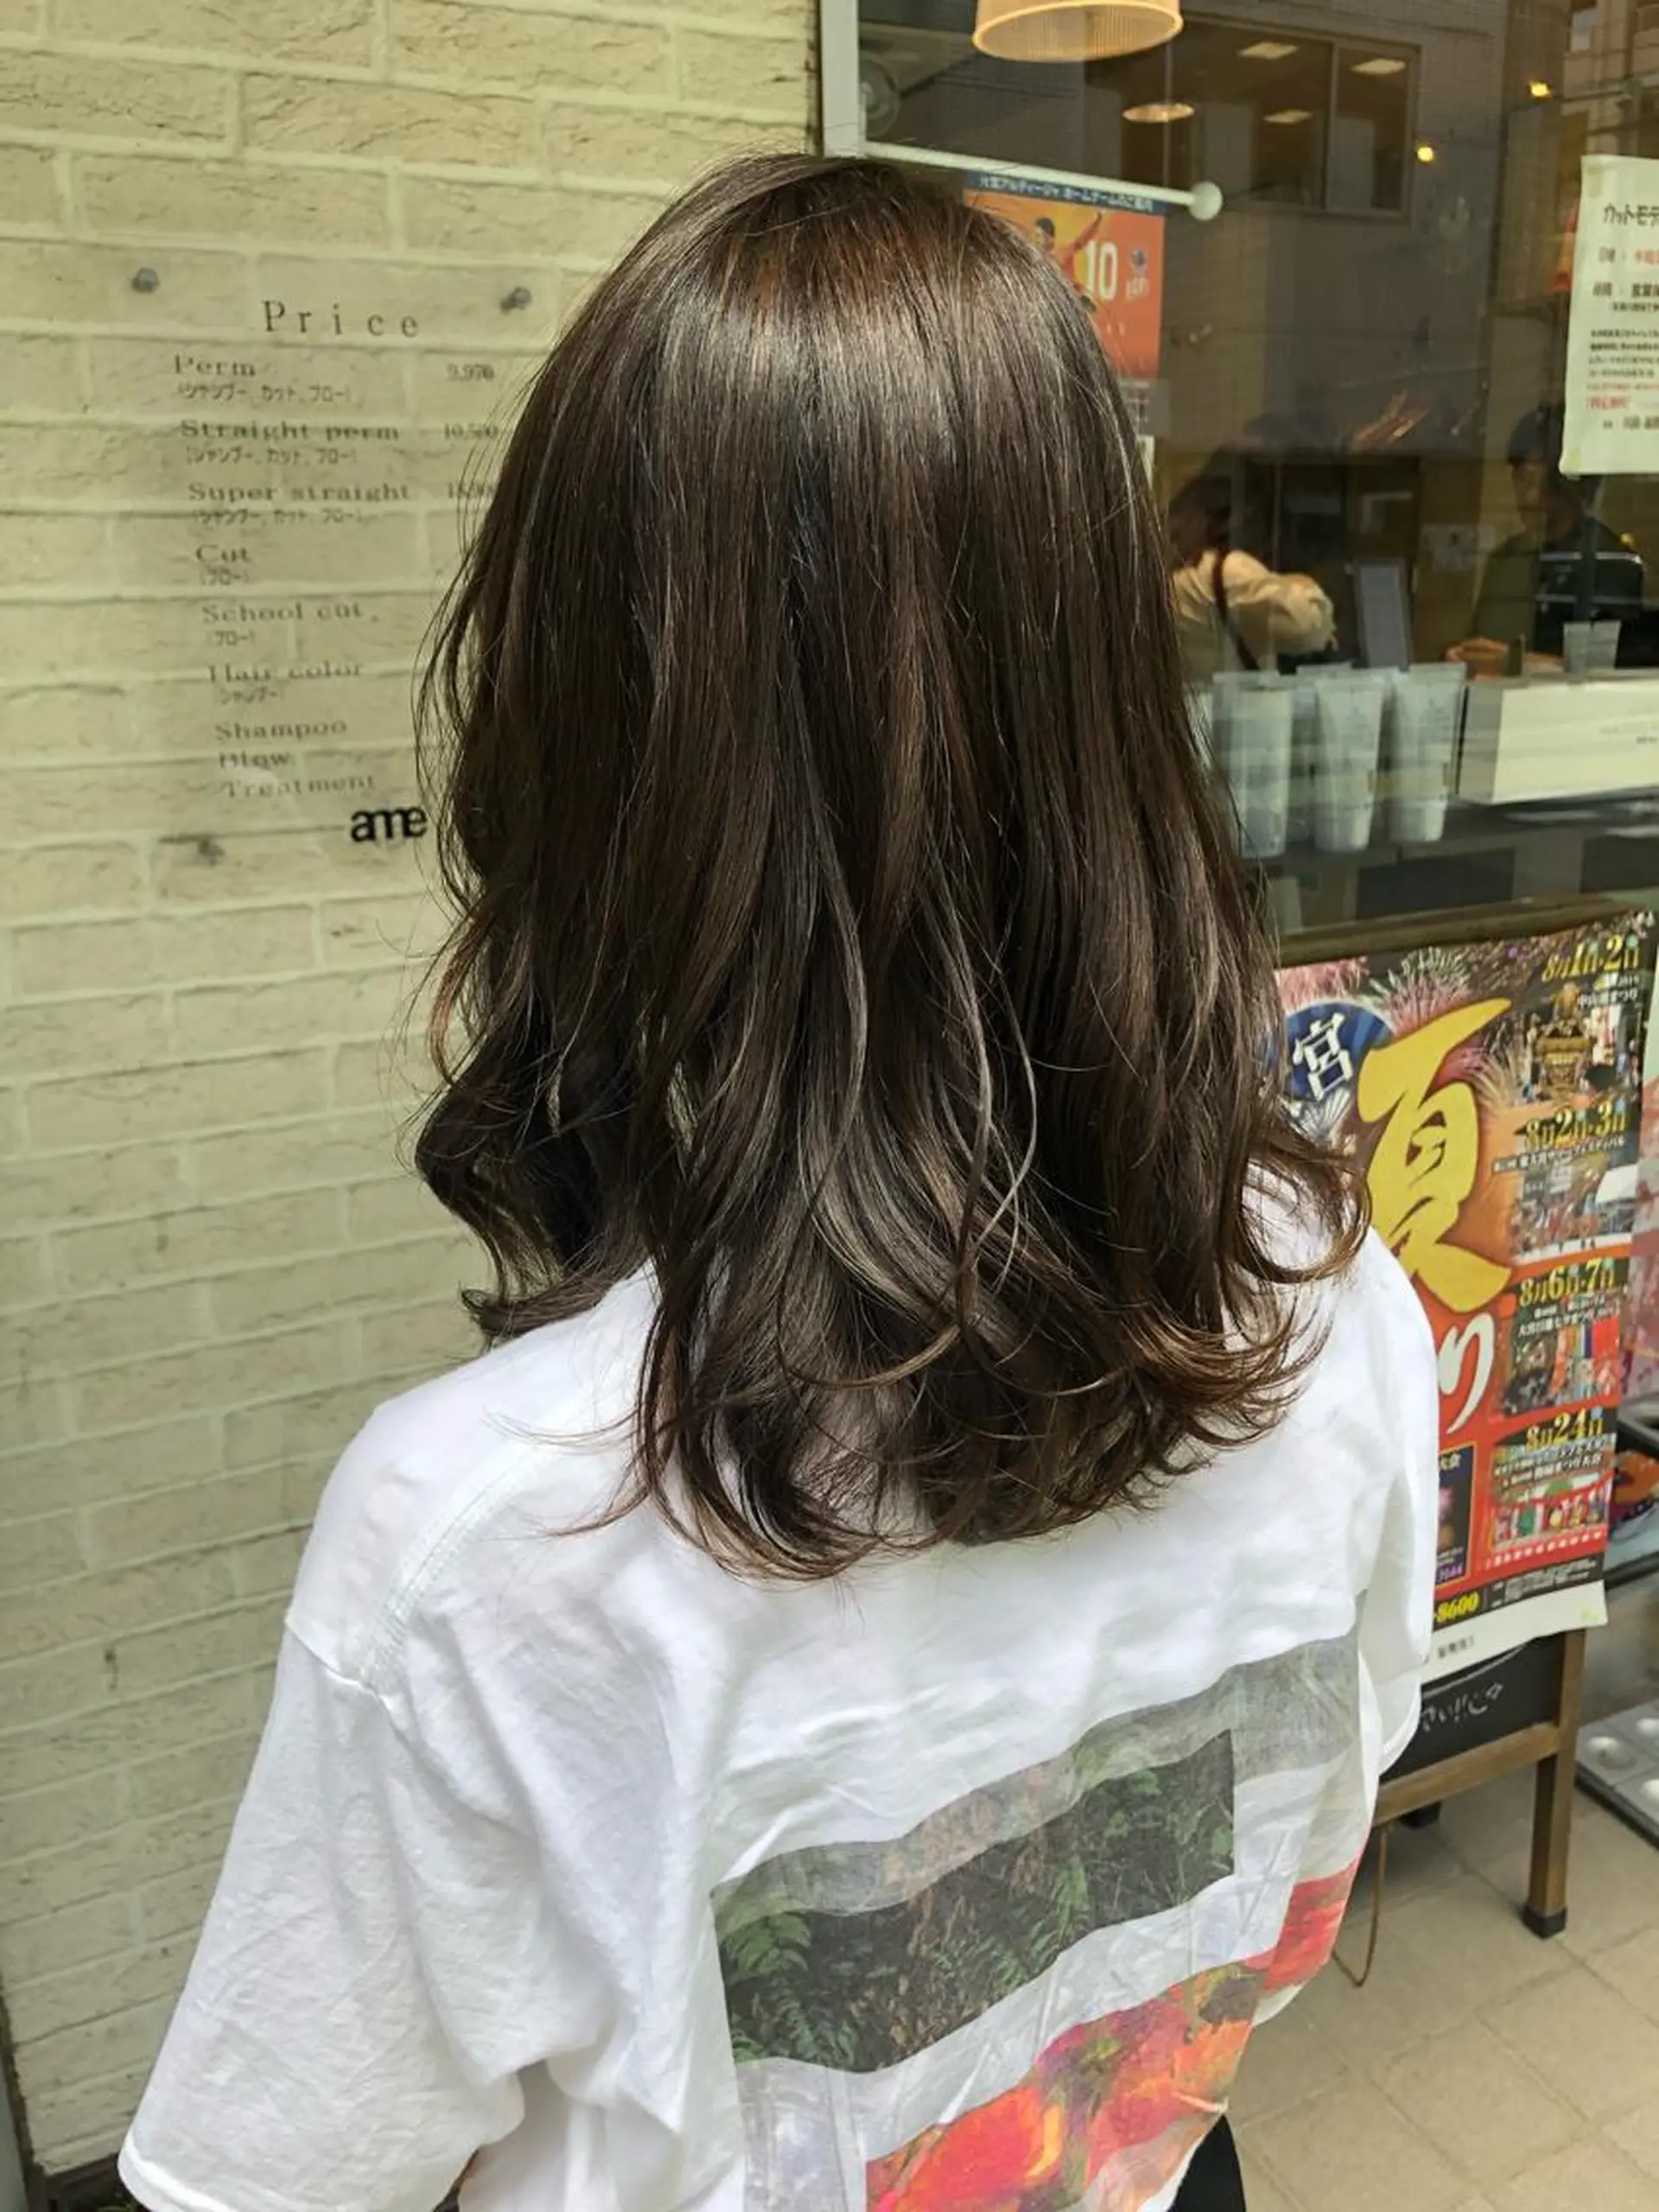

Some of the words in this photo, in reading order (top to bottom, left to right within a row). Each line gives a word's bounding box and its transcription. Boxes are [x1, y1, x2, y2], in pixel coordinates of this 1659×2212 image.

[1085, 239, 1118, 301] 10
[262, 299, 420, 338] Price
[175, 354, 256, 378] Perm
[181, 420, 308, 442] Straight
[326, 426, 399, 442] perm
[188, 482, 278, 503] Super
[290, 483, 410, 503] straight
[195, 543, 251, 563] Cut
[202, 602, 302, 623] School
[209, 663, 271, 683] Hair
[289, 659, 360, 679] color
[214, 721, 346, 741] Shampoo
[226, 775, 373, 798] Treatment
[1293, 1013, 1353, 1101] 宮
[1357, 997, 1512, 1313] 夏
